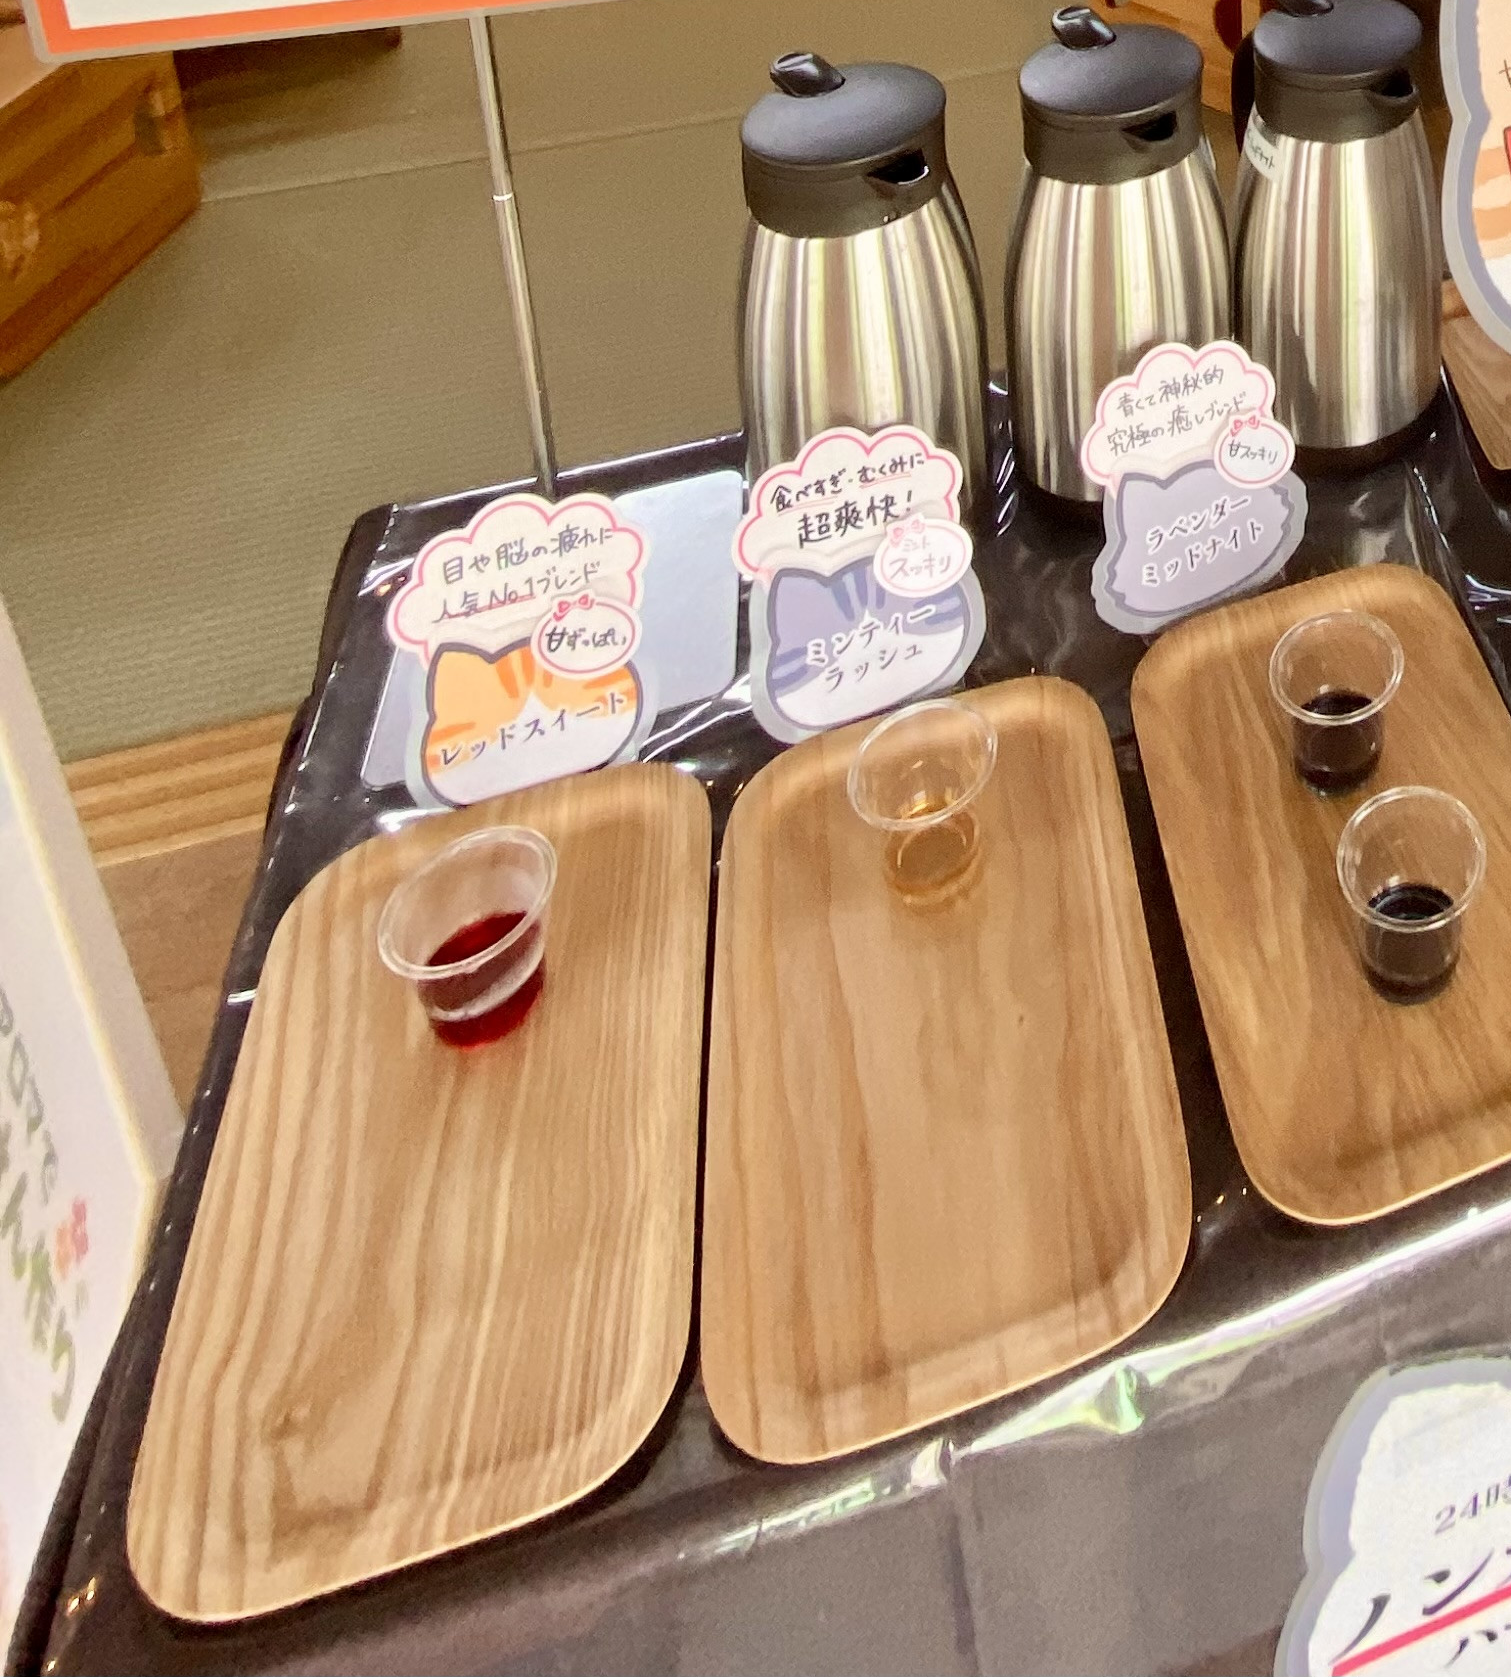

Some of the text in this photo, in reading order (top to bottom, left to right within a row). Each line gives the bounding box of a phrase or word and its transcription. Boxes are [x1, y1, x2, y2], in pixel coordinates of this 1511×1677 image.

[1116, 366, 1224, 417] 青くて神秘的
[1228, 441, 1278, 464] 甘スッキリ
[1148, 497, 1250, 551] ラベンダー
[443, 524, 613, 584] 目や脳の疲れに
[889, 554, 952, 580] スッキリ
[1144, 521, 1263, 586] ミッドナイト
[545, 627, 627, 653] 甘ずっぱい
[808, 606, 934, 664] ミンティー
[826, 643, 923, 693] ラッシュ
[441, 693, 625, 766] レッドスイート
